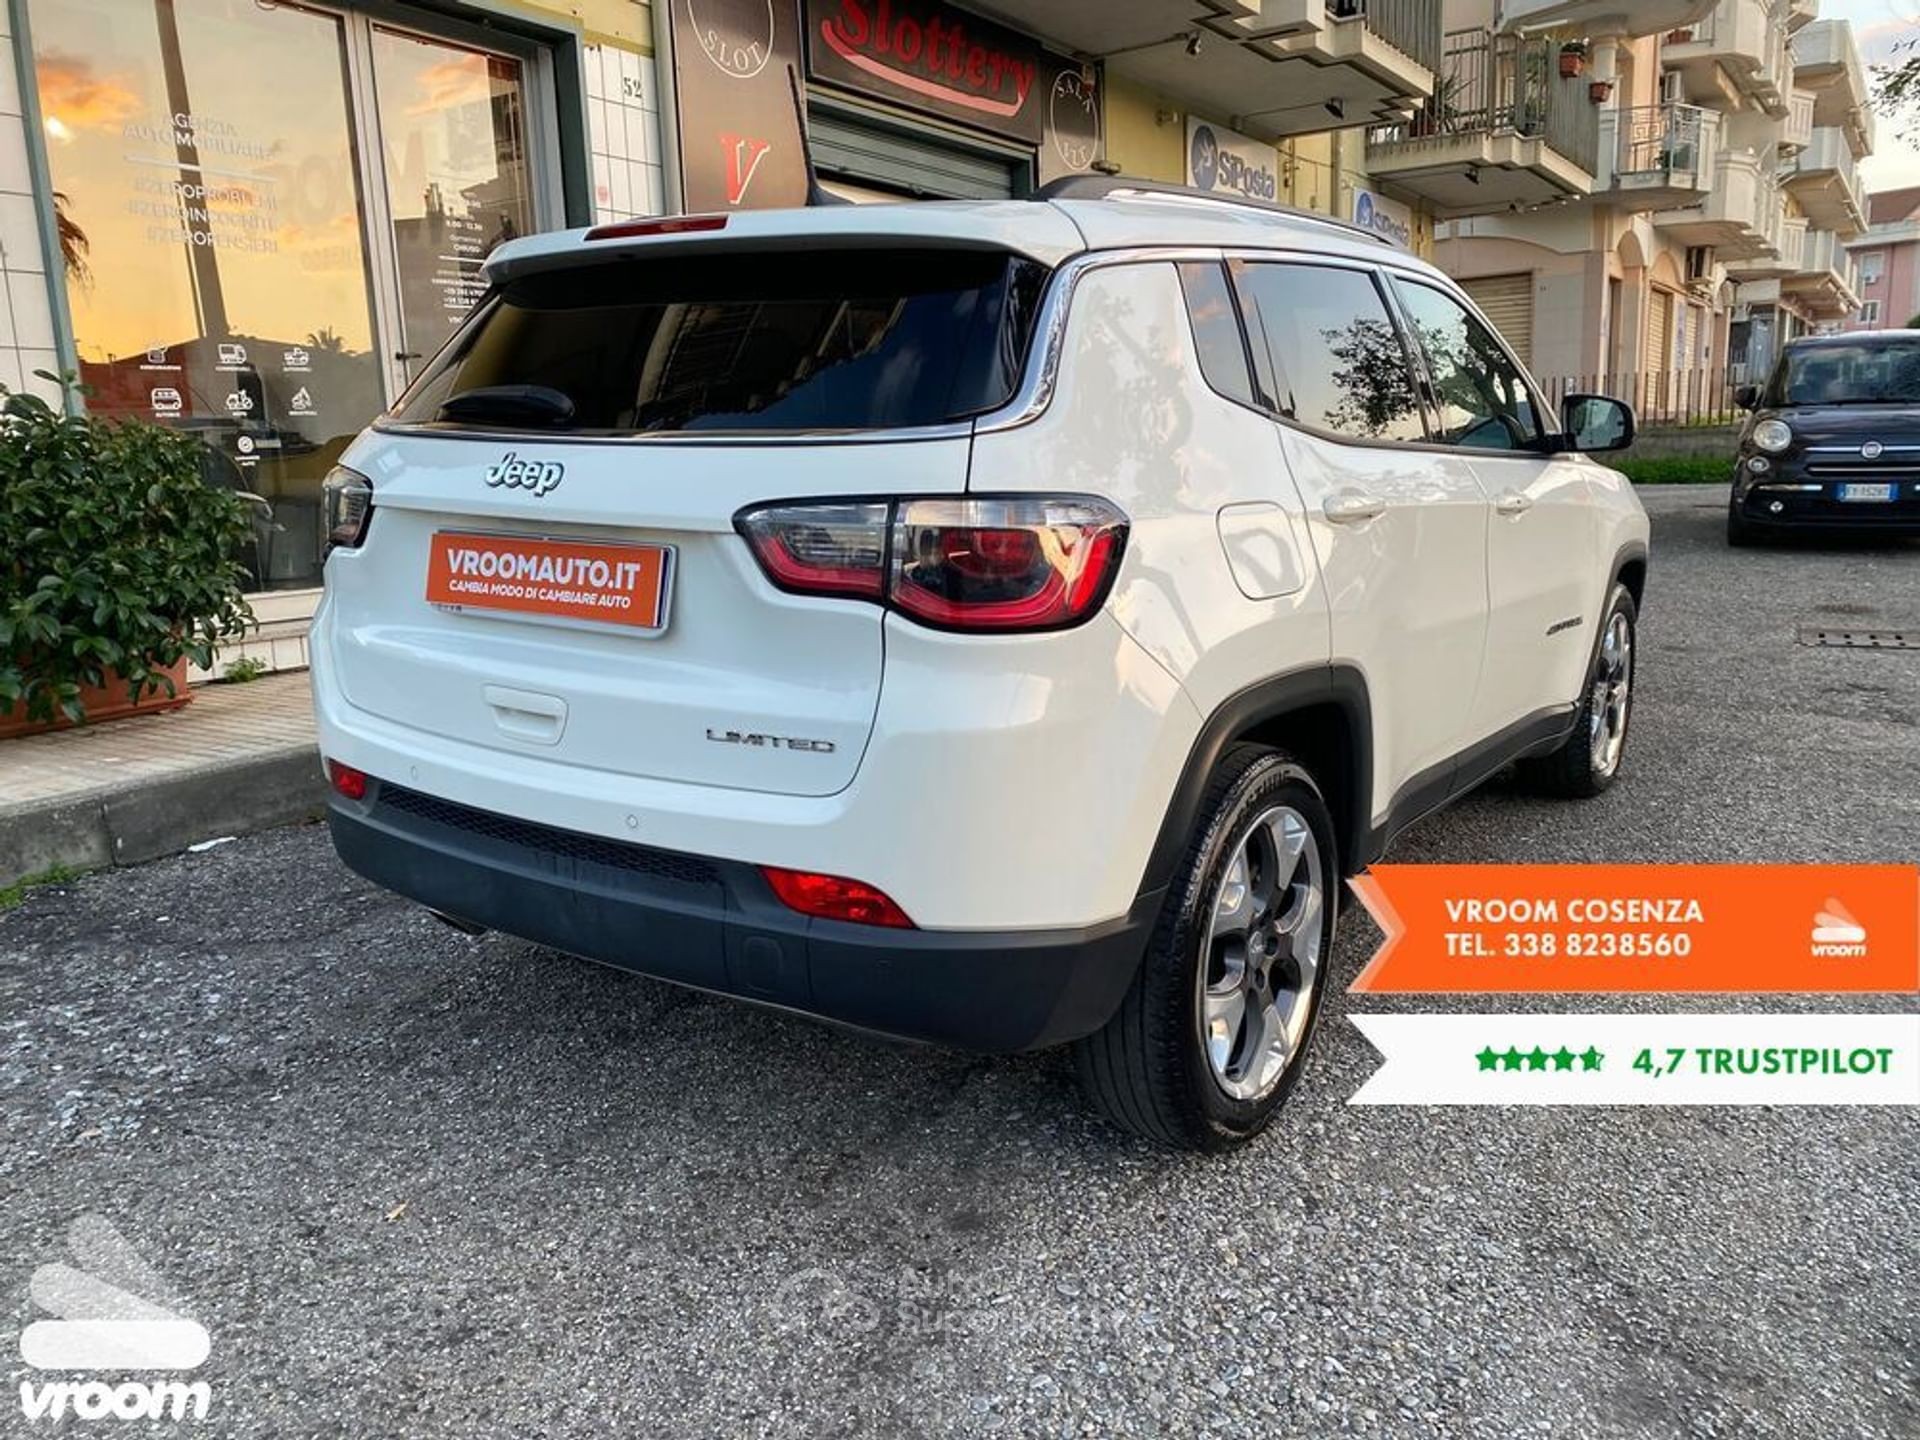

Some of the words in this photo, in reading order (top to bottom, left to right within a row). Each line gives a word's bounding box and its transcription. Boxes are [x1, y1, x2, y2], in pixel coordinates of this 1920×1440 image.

[705, 30, 763, 71] SLOT
[832, 0, 1036, 102] Slottery
[623, 76, 642, 98] 52
[485, 451, 564, 497] Jeep
[447, 548, 641, 591] VROOMAUTO.IT
[449, 579, 489, 595] CAMBIA
[490, 583, 523, 598] MODO
[524, 587, 537, 599] DI
[539, 588, 598, 607] CAMBIARE
[598, 594, 631, 609] AUTO
[706, 728, 836, 754] LIMITED
